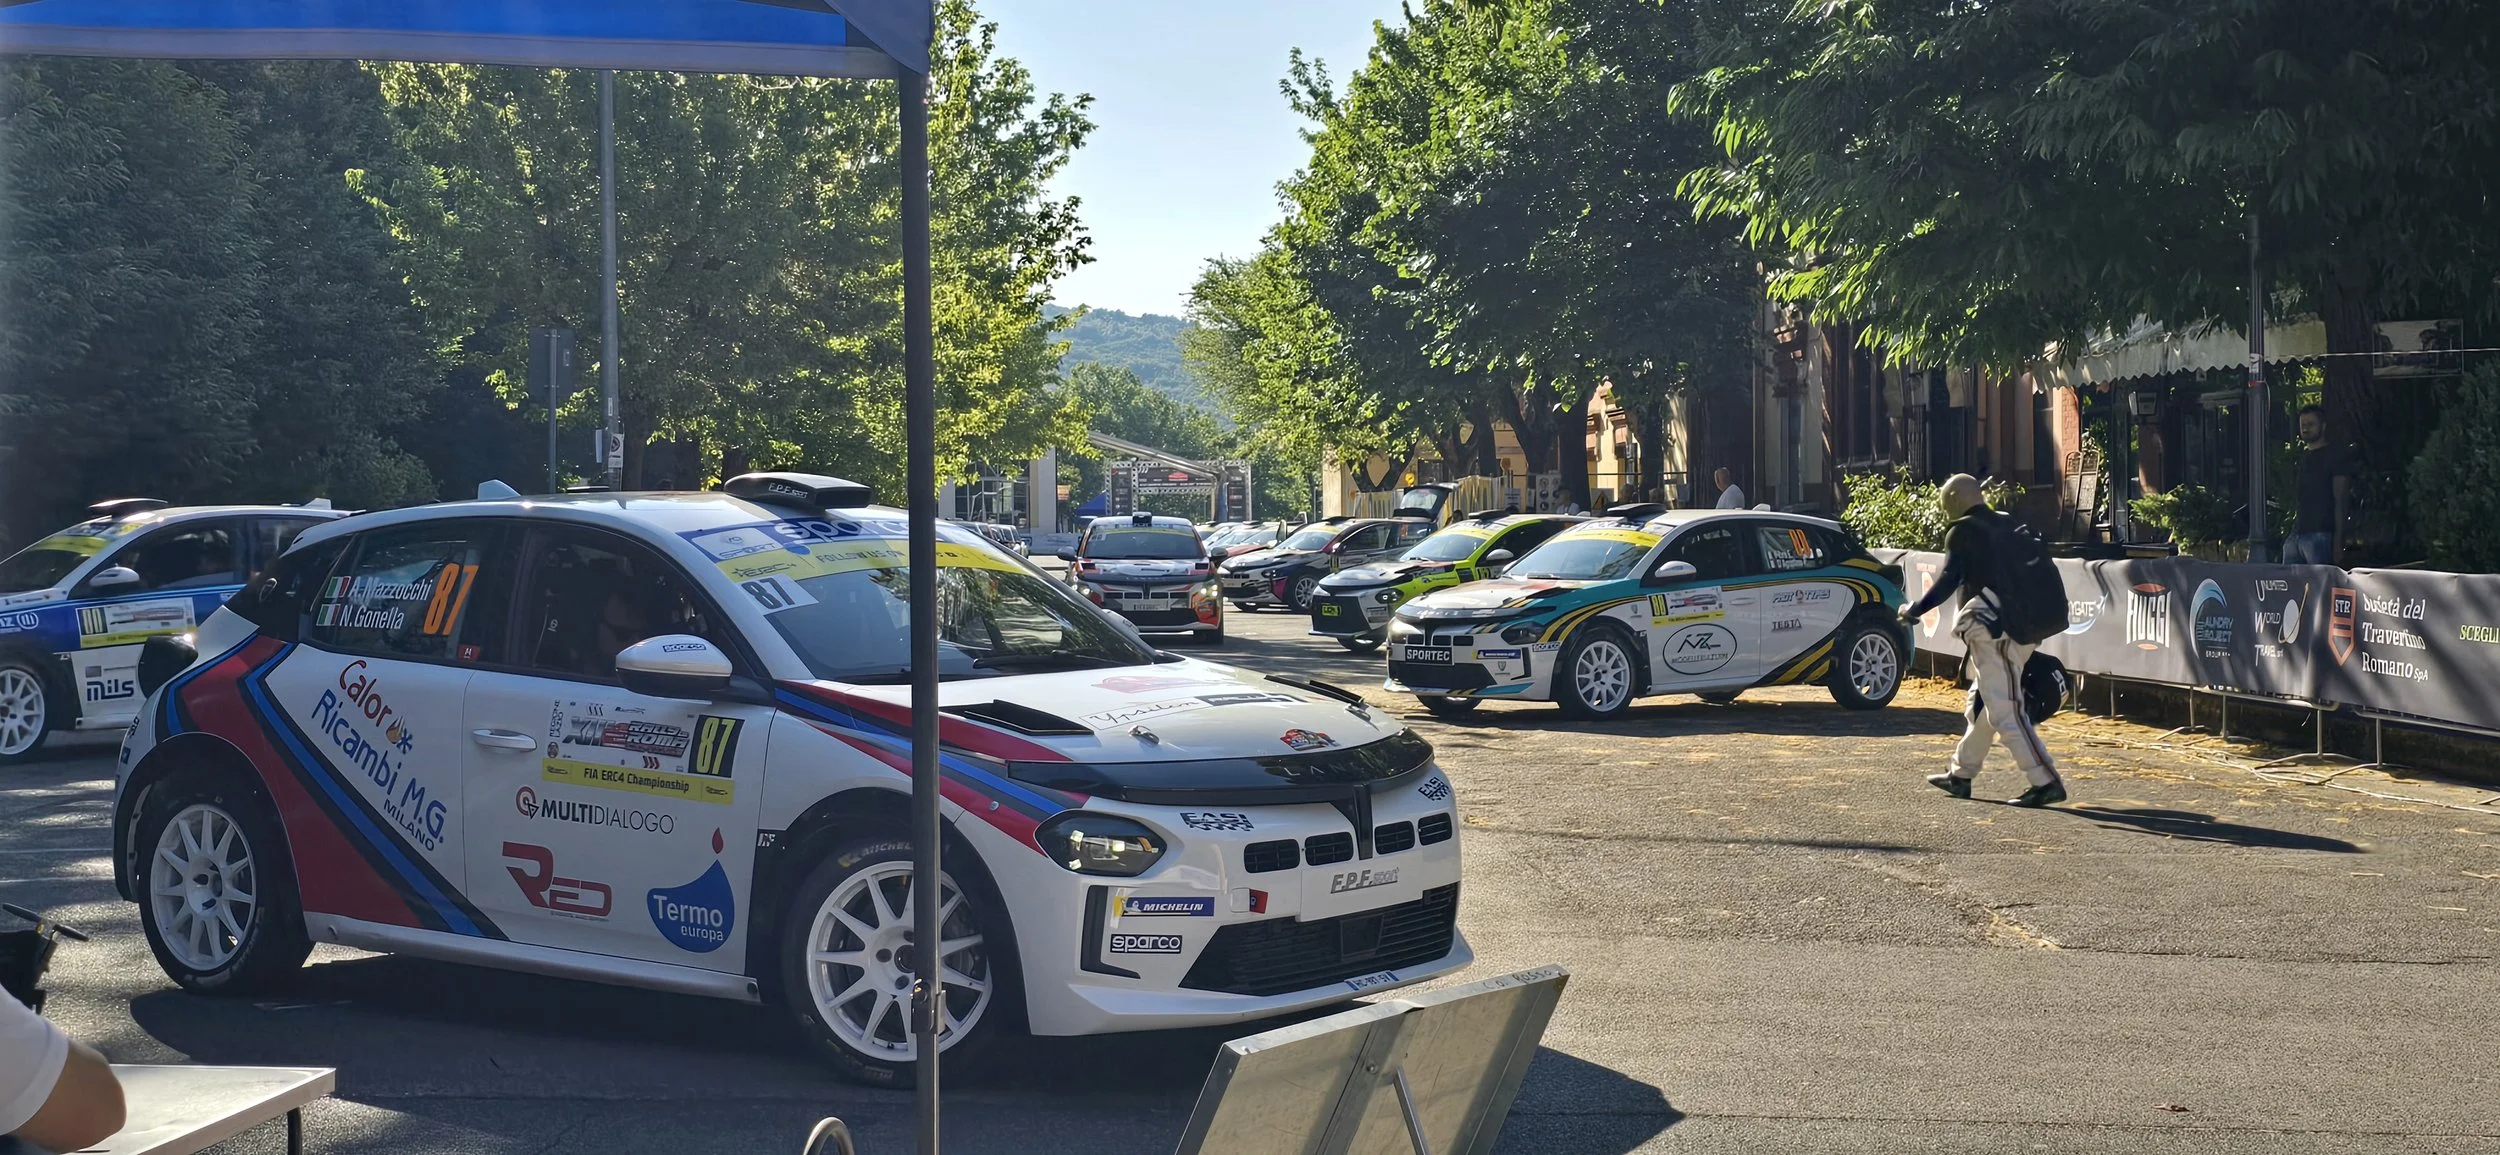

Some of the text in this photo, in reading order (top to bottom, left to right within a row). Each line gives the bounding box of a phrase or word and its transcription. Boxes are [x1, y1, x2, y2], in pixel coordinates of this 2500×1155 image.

[774, 520, 911, 543] sparc
[815, 551, 870, 564] FOLLOW
[423, 563, 479, 635] 87
[741, 577, 796, 610] 87
[2335, 599, 2351, 614] STR
[2402, 598, 2426, 620] del
[2254, 611, 2281, 633] WORLD
[2459, 624, 2500, 643] SCEGLI
[1406, 649, 1450, 661] SPORTEC
[2362, 652, 2413, 679] Romano
[339, 660, 393, 727] Calor
[627, 732, 690, 749] ROMA
[696, 717, 736, 775] 87
[311, 688, 447, 844] Ricambi M.G.
[583, 767, 599, 780] FIA
[602, 769, 625, 783] ERC4
[627, 774, 691, 794] Championship
[383, 798, 435, 851] MILANO
[541, 799, 675, 834] MULTIDIALOGO
[502, 841, 613, 917] RED
[653, 895, 724, 927] Termo
[1143, 902, 1204, 911] MICHELIN
[681, 924, 724, 942] europa
[1112, 935, 1181, 952] sparco
